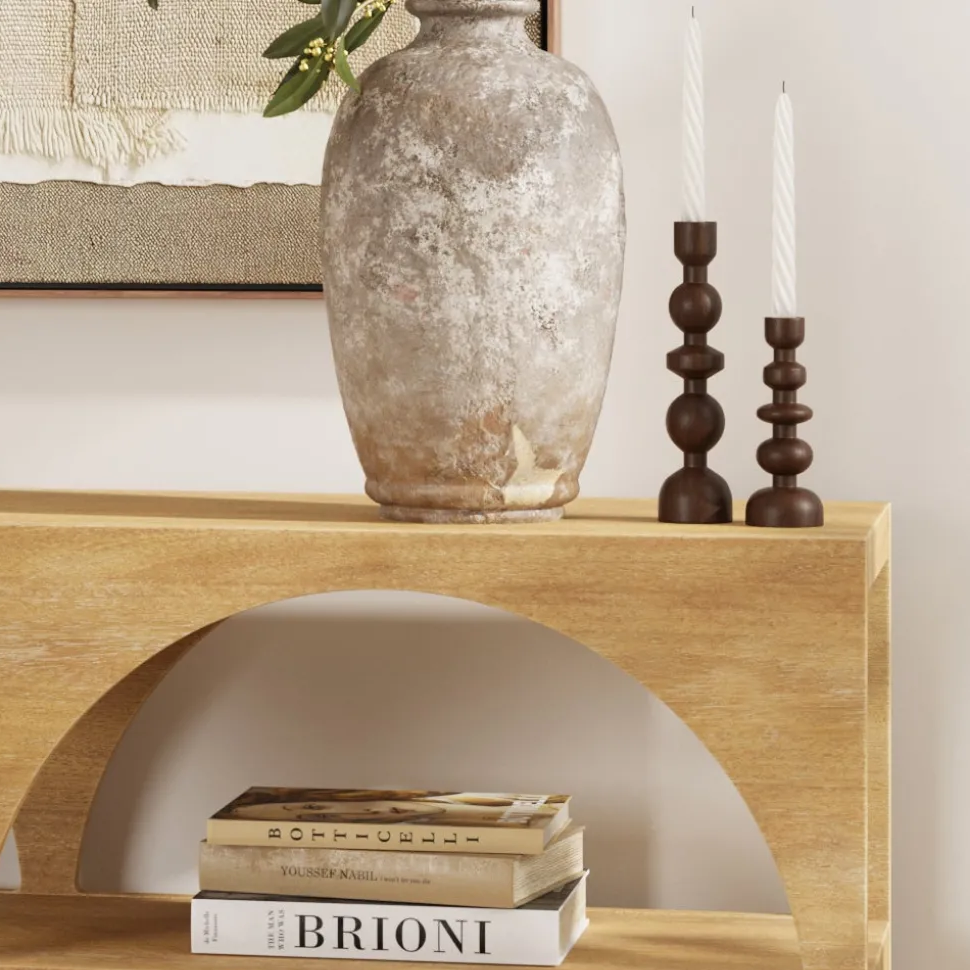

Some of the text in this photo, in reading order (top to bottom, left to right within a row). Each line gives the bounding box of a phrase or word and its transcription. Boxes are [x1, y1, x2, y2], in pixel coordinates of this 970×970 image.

[269, 827, 480, 844] BOTTICELLI
[280, 865, 337, 879] YOUSSEF
[339, 867, 378, 881] NABIL
[294, 914, 492, 955] BRIONI
